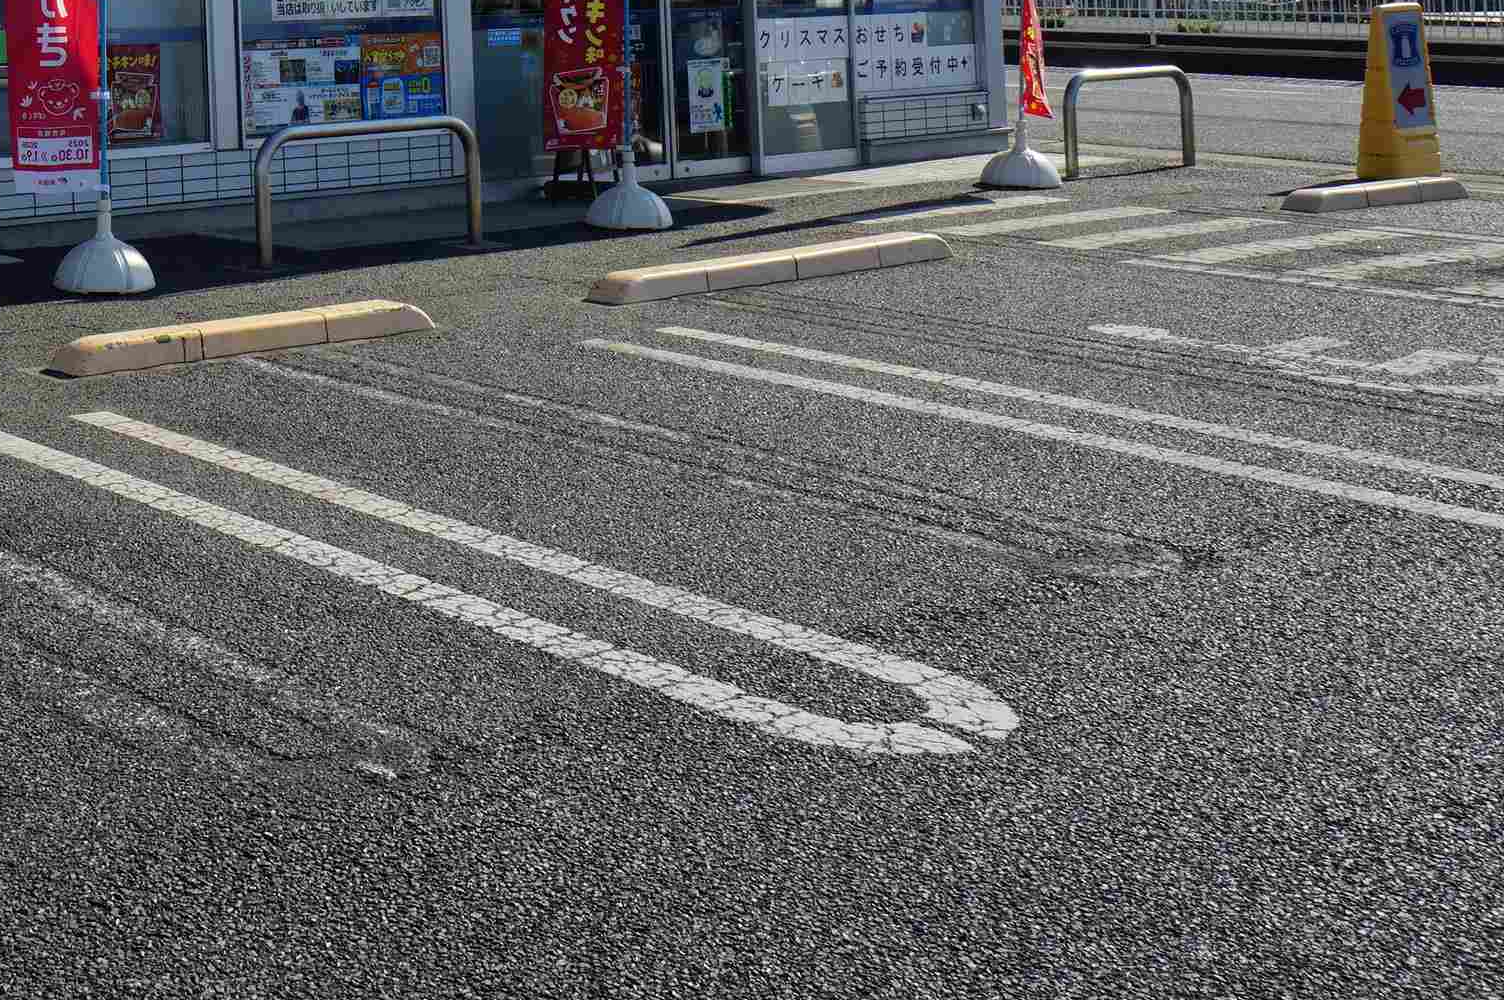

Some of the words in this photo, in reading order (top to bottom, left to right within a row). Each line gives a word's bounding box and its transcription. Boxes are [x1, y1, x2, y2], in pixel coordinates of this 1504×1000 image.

[759, 28, 846, 48] クリスマス
[855, 26, 905, 45] おせち
[856, 56, 960, 80] ご予約受付中
[771, 71, 825, 93] ケーキ
